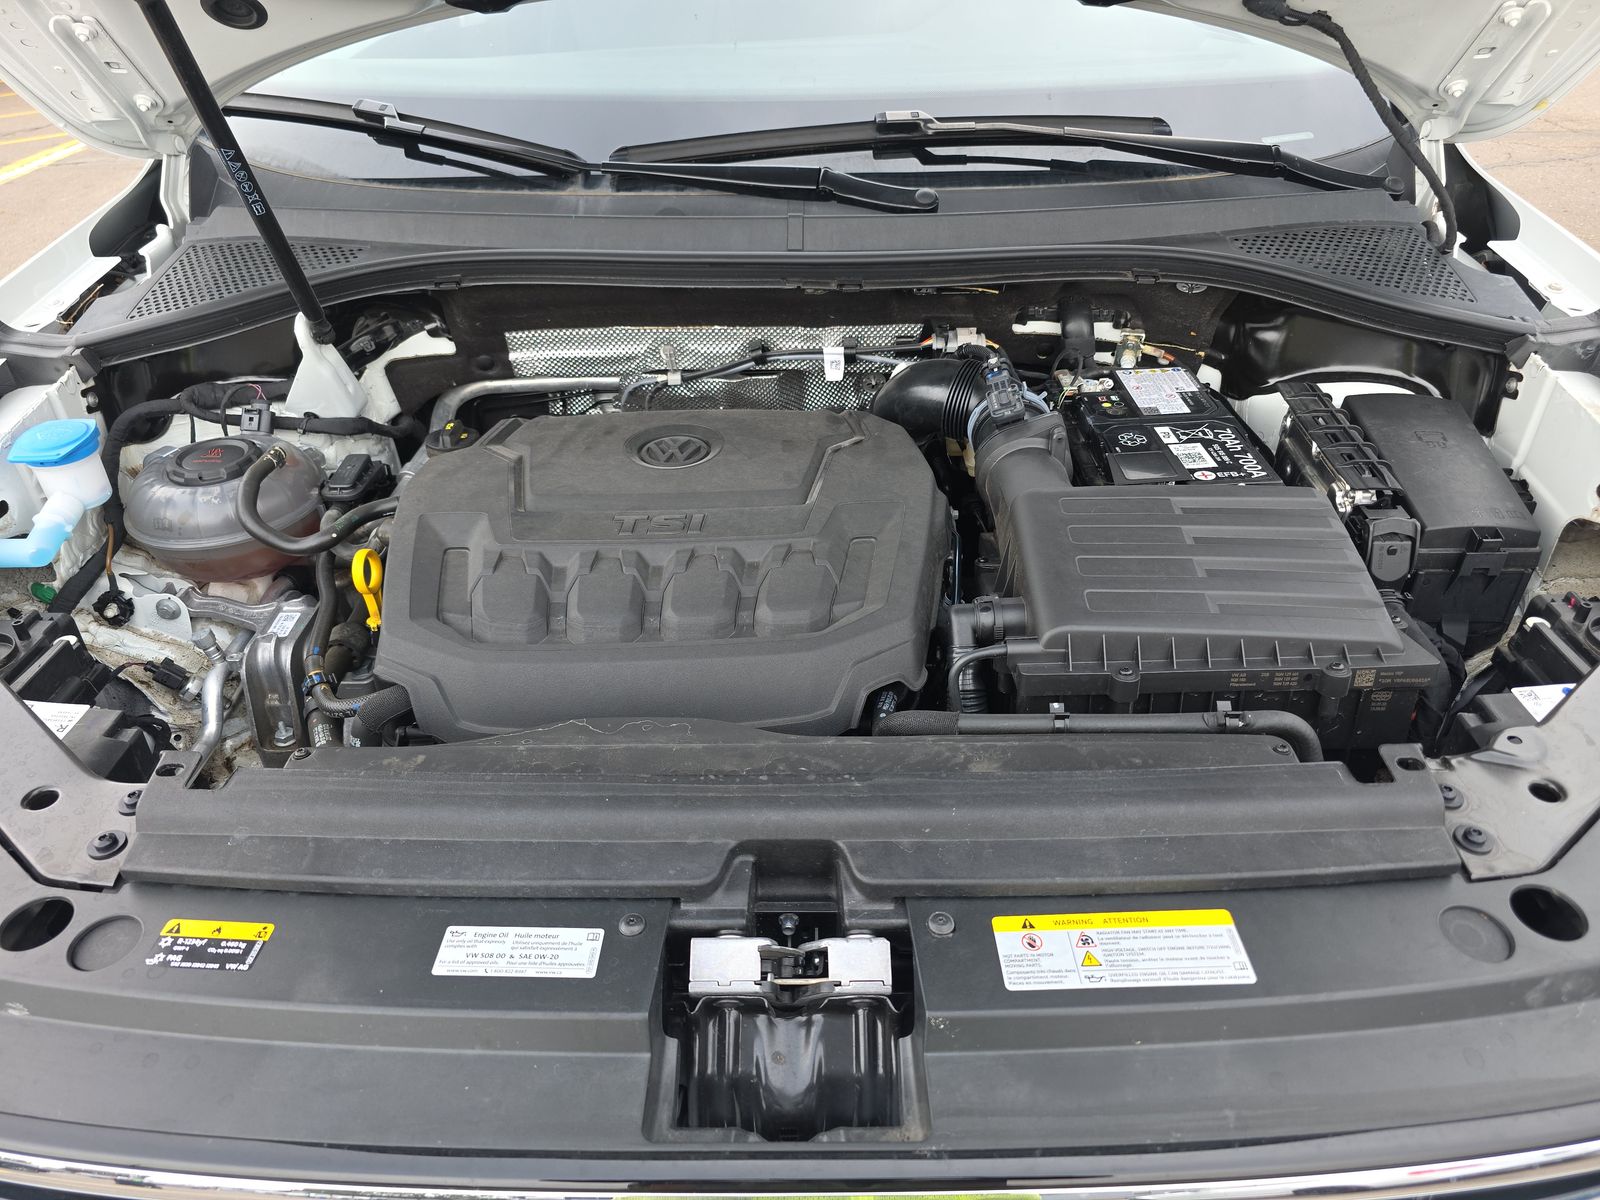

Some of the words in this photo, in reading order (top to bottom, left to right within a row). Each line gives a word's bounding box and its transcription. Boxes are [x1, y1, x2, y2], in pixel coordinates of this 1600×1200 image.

[1213, 428, 1244, 452] 70Ah
[1233, 452, 1268, 479] 700A
[612, 513, 707, 535] TSI
[1052, 918, 1094, 926] WARNING
[1103, 916, 1149, 925] ATTENTION
[473, 931, 498, 939] Engine
[225, 963, 239, 971] VW
